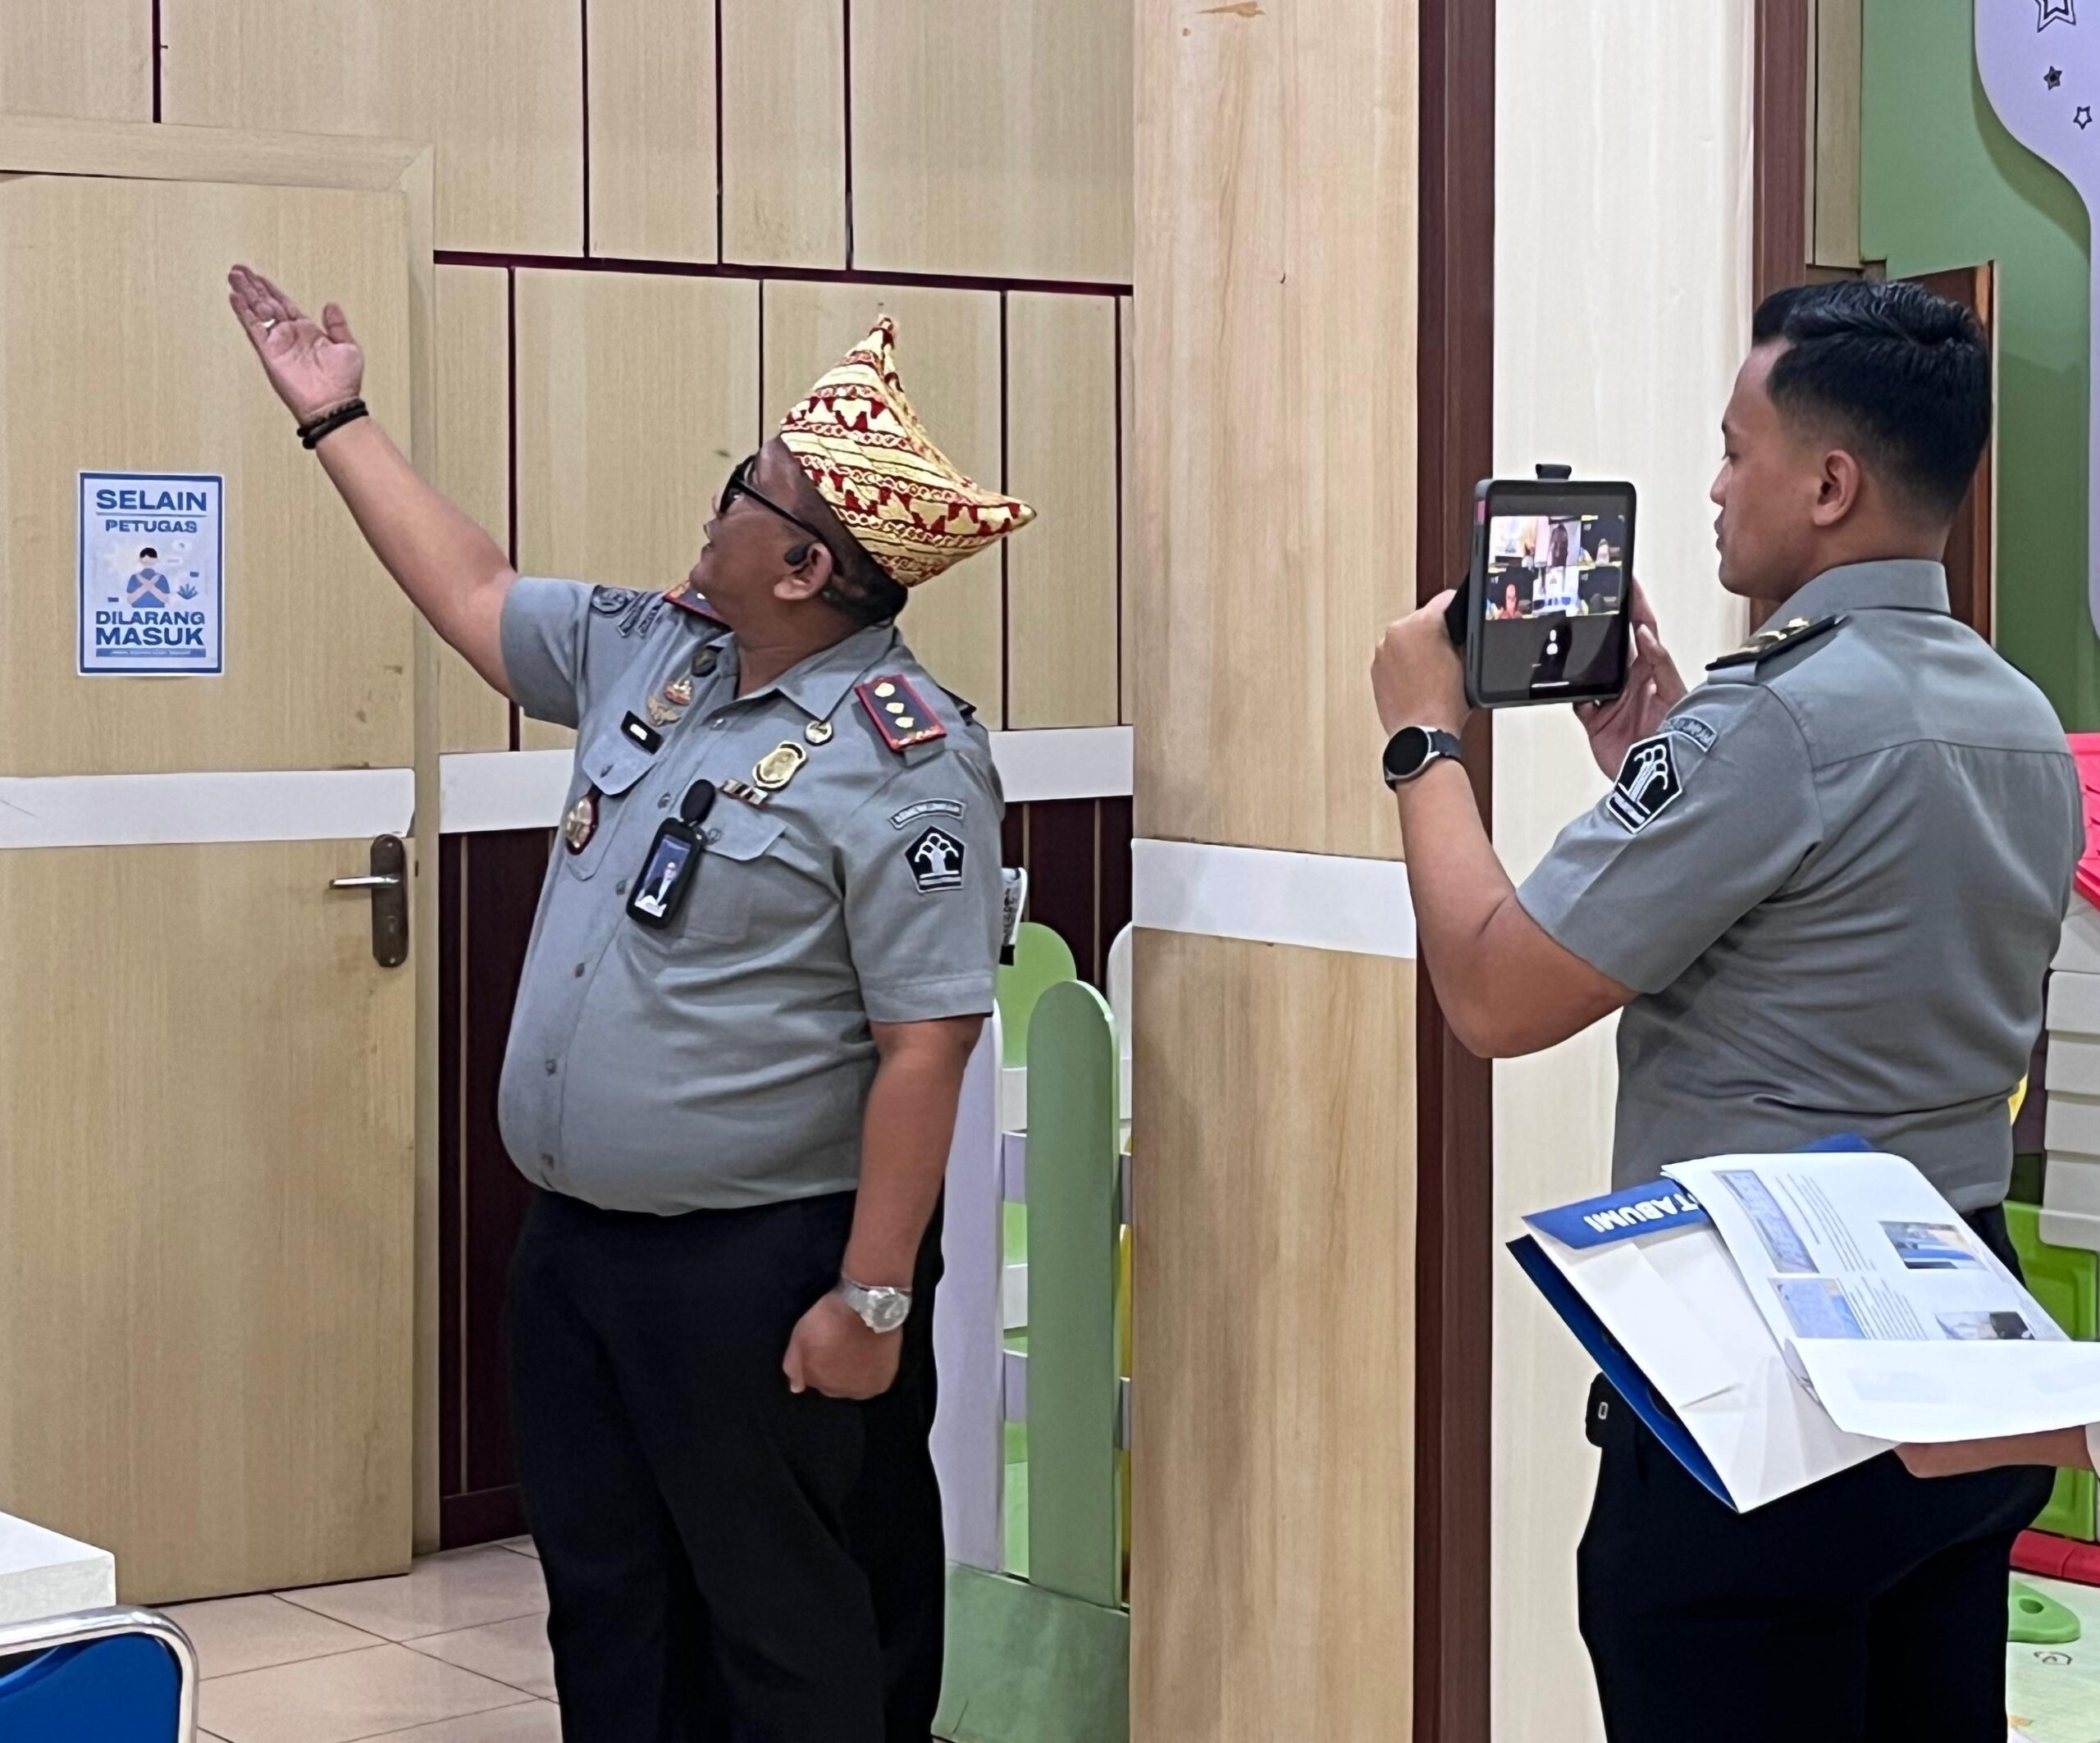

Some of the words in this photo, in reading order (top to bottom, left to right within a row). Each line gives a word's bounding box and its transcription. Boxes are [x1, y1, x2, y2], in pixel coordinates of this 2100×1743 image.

[96, 490, 207, 511] SELAIN
[105, 519, 198, 533] PETUGAS
[96, 611, 205, 625] DILARANG
[96, 627, 204, 646] MASUK
[1583, 1193, 1698, 1233] TABUMI
